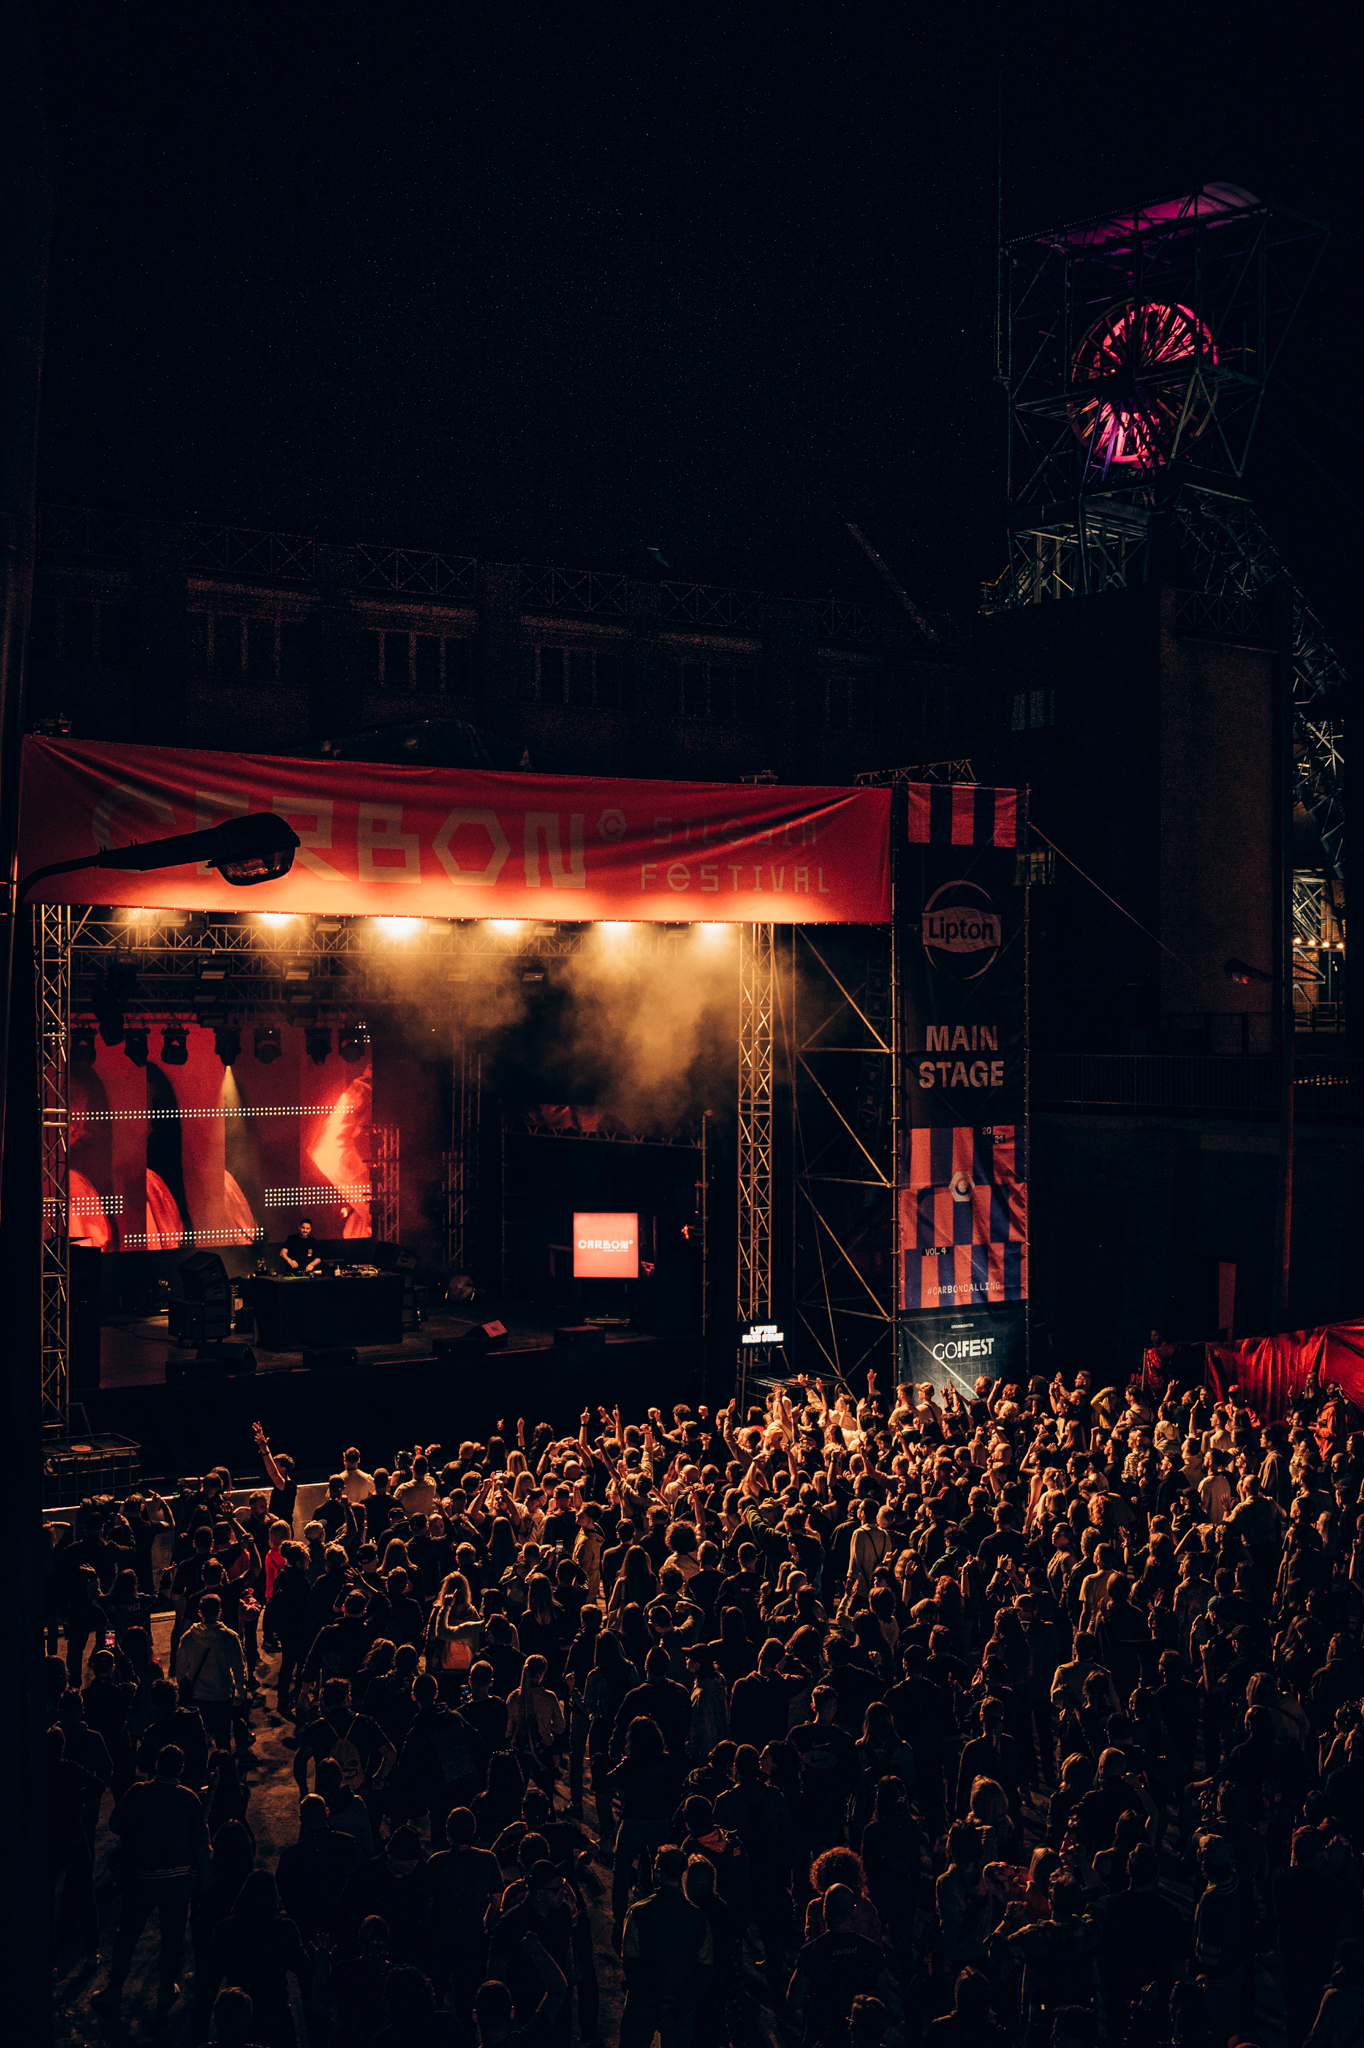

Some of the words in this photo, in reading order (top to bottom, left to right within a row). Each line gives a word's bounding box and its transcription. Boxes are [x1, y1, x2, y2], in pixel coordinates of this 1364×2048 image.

[928, 917, 994, 943] Lipton
[926, 1025, 998, 1052] MAIN
[918, 1061, 1004, 1088] STAGE
[982, 1126, 992, 1135] 20
[927, 1281, 1001, 1296] #CARBONCALLING
[932, 1337, 995, 1360] GO!FEST
